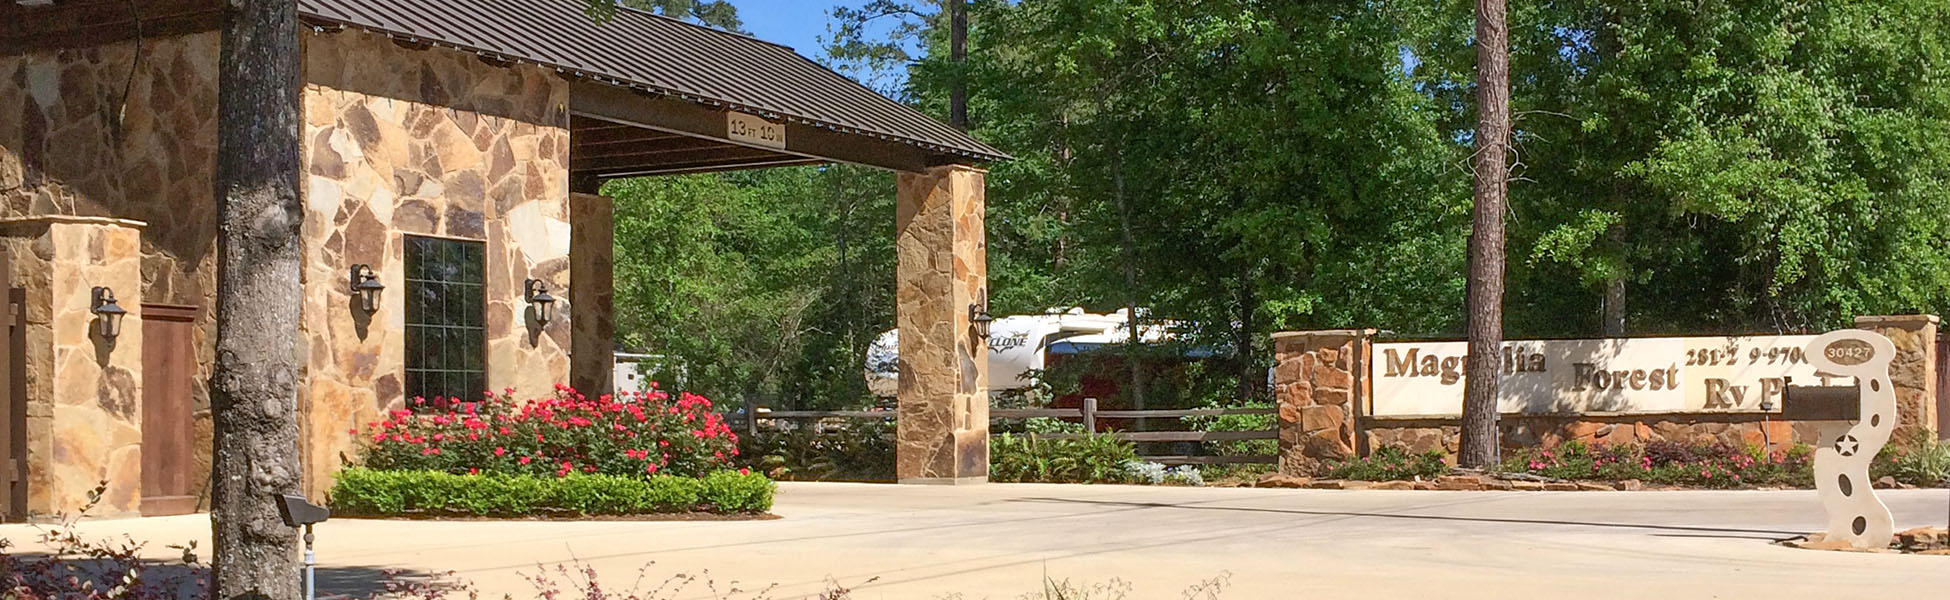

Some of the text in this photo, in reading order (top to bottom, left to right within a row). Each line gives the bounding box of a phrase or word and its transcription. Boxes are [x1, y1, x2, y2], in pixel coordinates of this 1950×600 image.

[731, 119, 747, 136] 13
[760, 124, 775, 141] 10
[988, 337, 1028, 347] CLONE
[1827, 347, 1871, 359] 30427
[1384, 346, 1546, 386] Maglia
[1572, 362, 1680, 391] Forest
[1703, 378, 1749, 409] Rv
